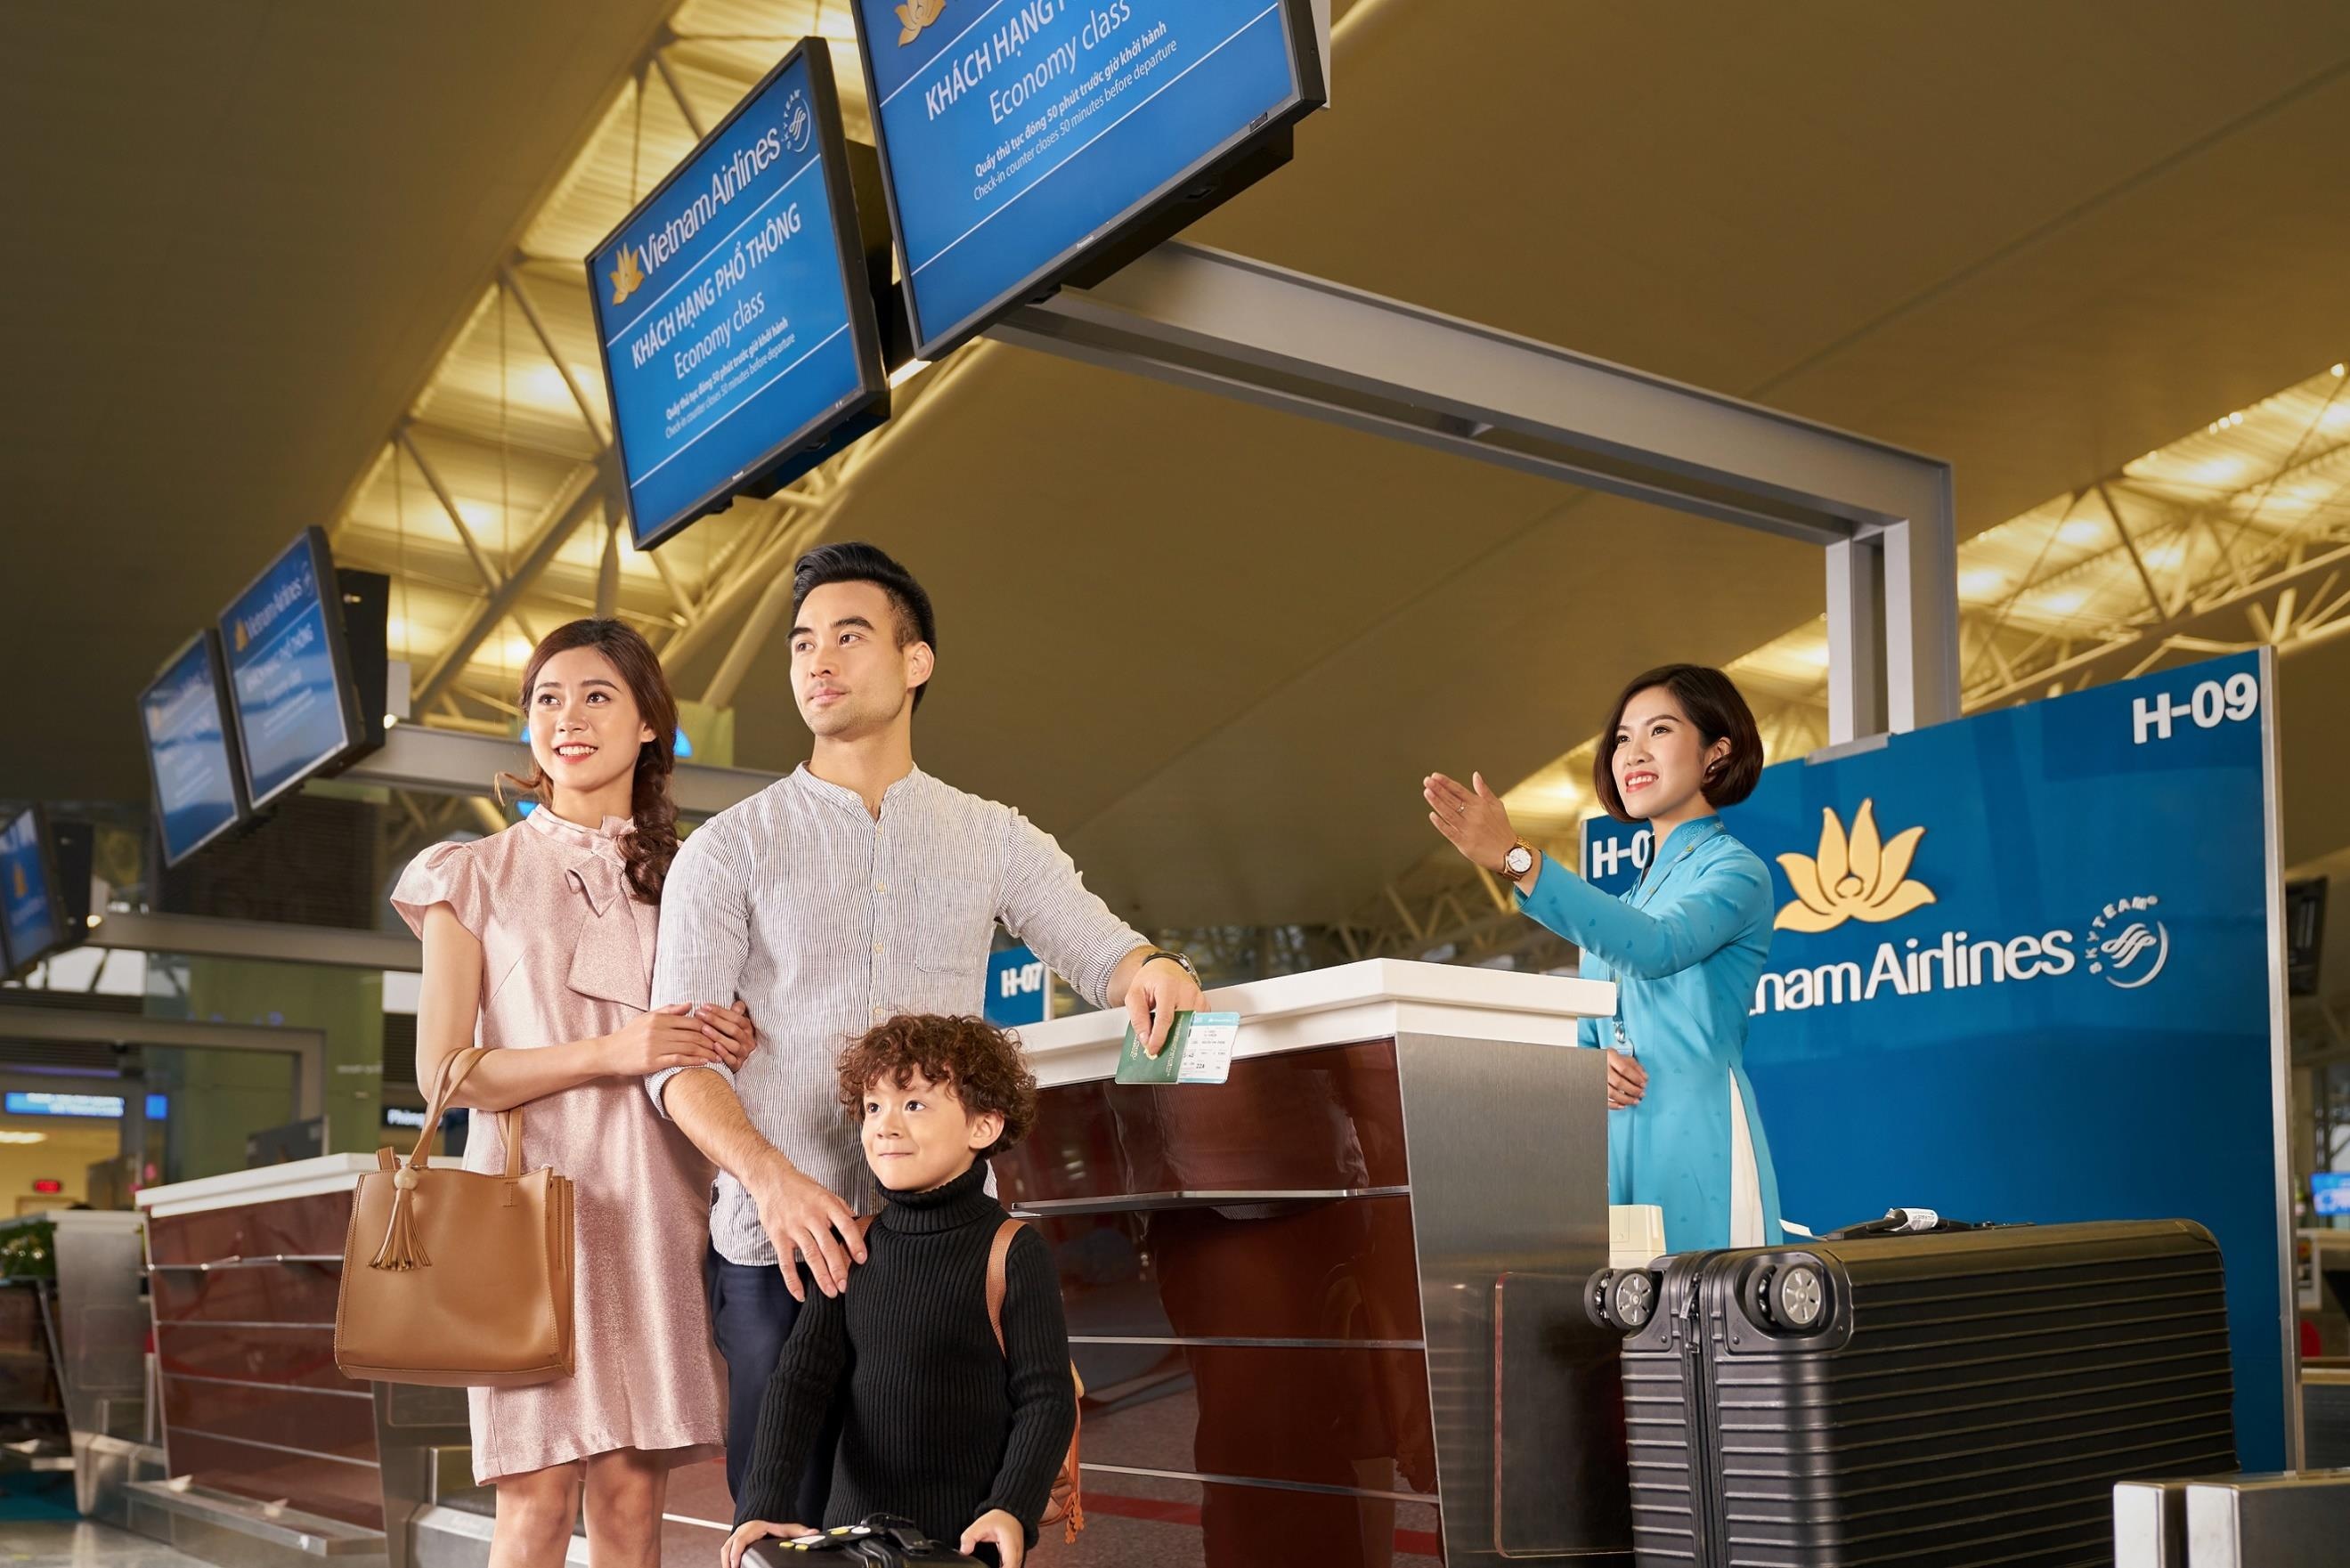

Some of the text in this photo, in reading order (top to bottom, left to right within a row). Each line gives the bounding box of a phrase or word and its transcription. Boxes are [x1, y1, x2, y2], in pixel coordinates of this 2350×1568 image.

[925, 0, 1053, 122] KHÁCH HẠNG
[989, 0, 1131, 125] Economy class
[1047, 104, 1058, 123] 50
[1059, 88, 1080, 117] phút
[1141, 20, 1167, 49] hành
[973, 39, 1177, 200] Check-in counter closes 50 minutes before departure
[631, 202, 801, 370] KHÁCH HẠNG PHỔ THÔNG
[674, 291, 765, 380] Economy class
[2133, 672, 2258, 744] H-09
[1592, 829, 1653, 879] H-0
[1000, 962, 1043, 998] H-07
[2085, 896, 2148, 974] SKYTEAM
